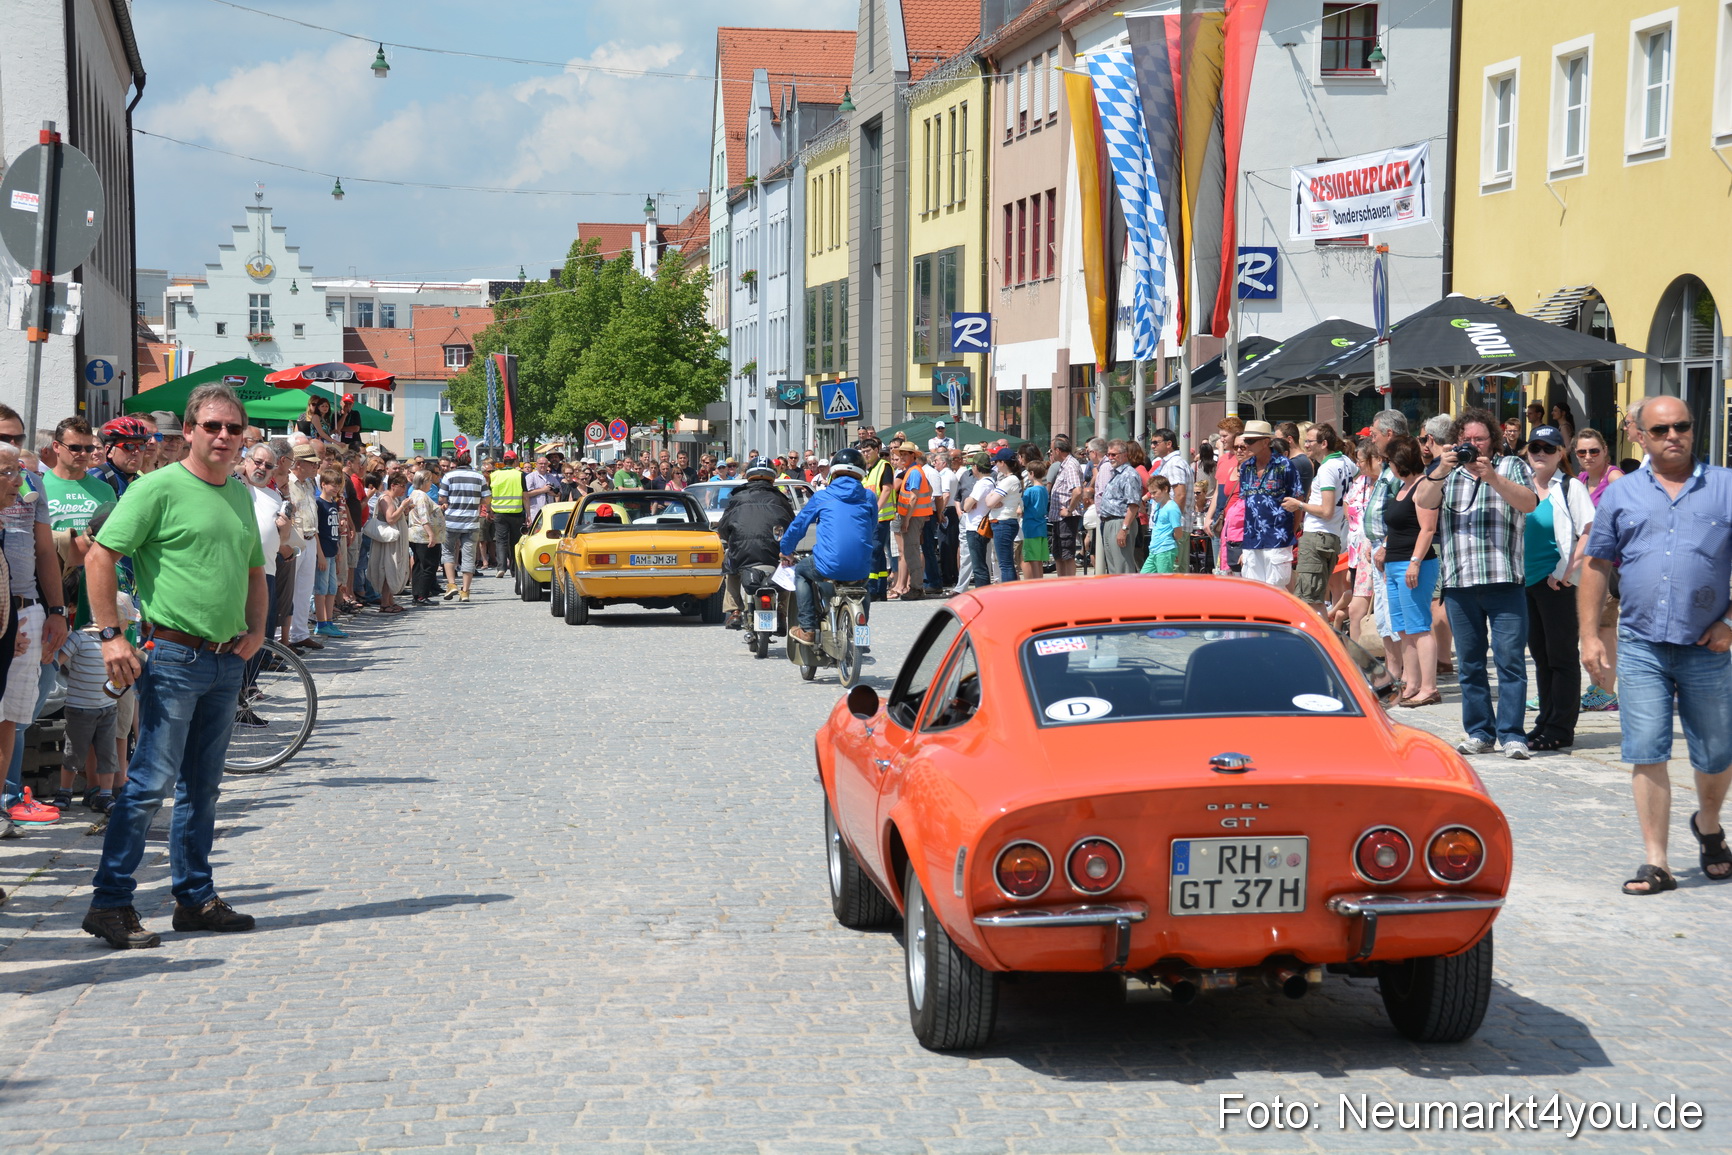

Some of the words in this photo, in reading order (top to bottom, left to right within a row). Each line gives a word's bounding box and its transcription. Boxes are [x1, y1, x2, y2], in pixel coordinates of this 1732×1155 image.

[1309, 160, 1412, 202] RESIDENZPLATZ
[1333, 204, 1392, 225] Sonderschauen
[590, 427, 602, 438] 30
[635, 556, 647, 565] AM
[652, 556, 664, 565] JM
[665, 556, 677, 565] 3H
[1038, 636, 1085, 648] LIQUI
[1040, 643, 1088, 655] MOLY
[1067, 702, 1090, 716] D
[1206, 802, 1270, 811] OPEL
[1220, 817, 1256, 828] GT
[1218, 844, 1261, 874] RH
[1180, 880, 1222, 909] GT
